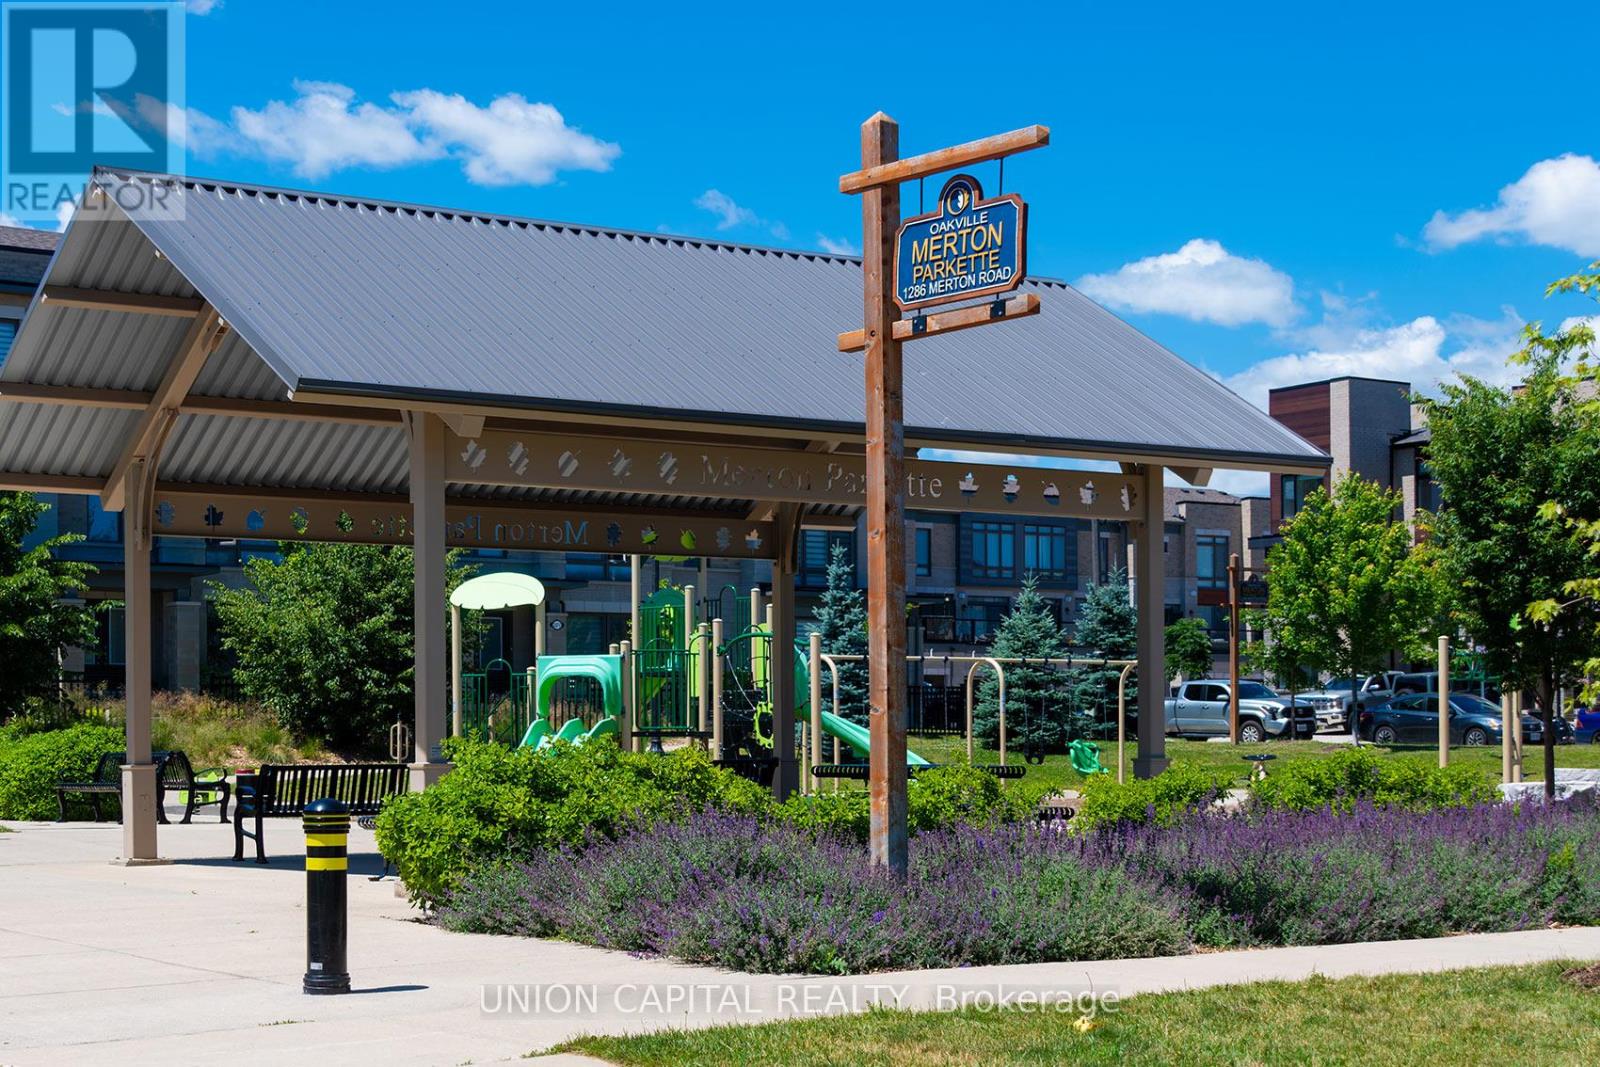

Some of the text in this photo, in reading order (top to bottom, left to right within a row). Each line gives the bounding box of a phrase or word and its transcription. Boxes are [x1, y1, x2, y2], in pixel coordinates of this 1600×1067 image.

[929, 211, 989, 235] OAKVILLE
[911, 220, 1003, 265] MERTON
[903, 266, 1012, 300] 1286 MERTON ROAD
[912, 248, 1000, 284] PARKETTE
[825, 462, 943, 498] Partte
